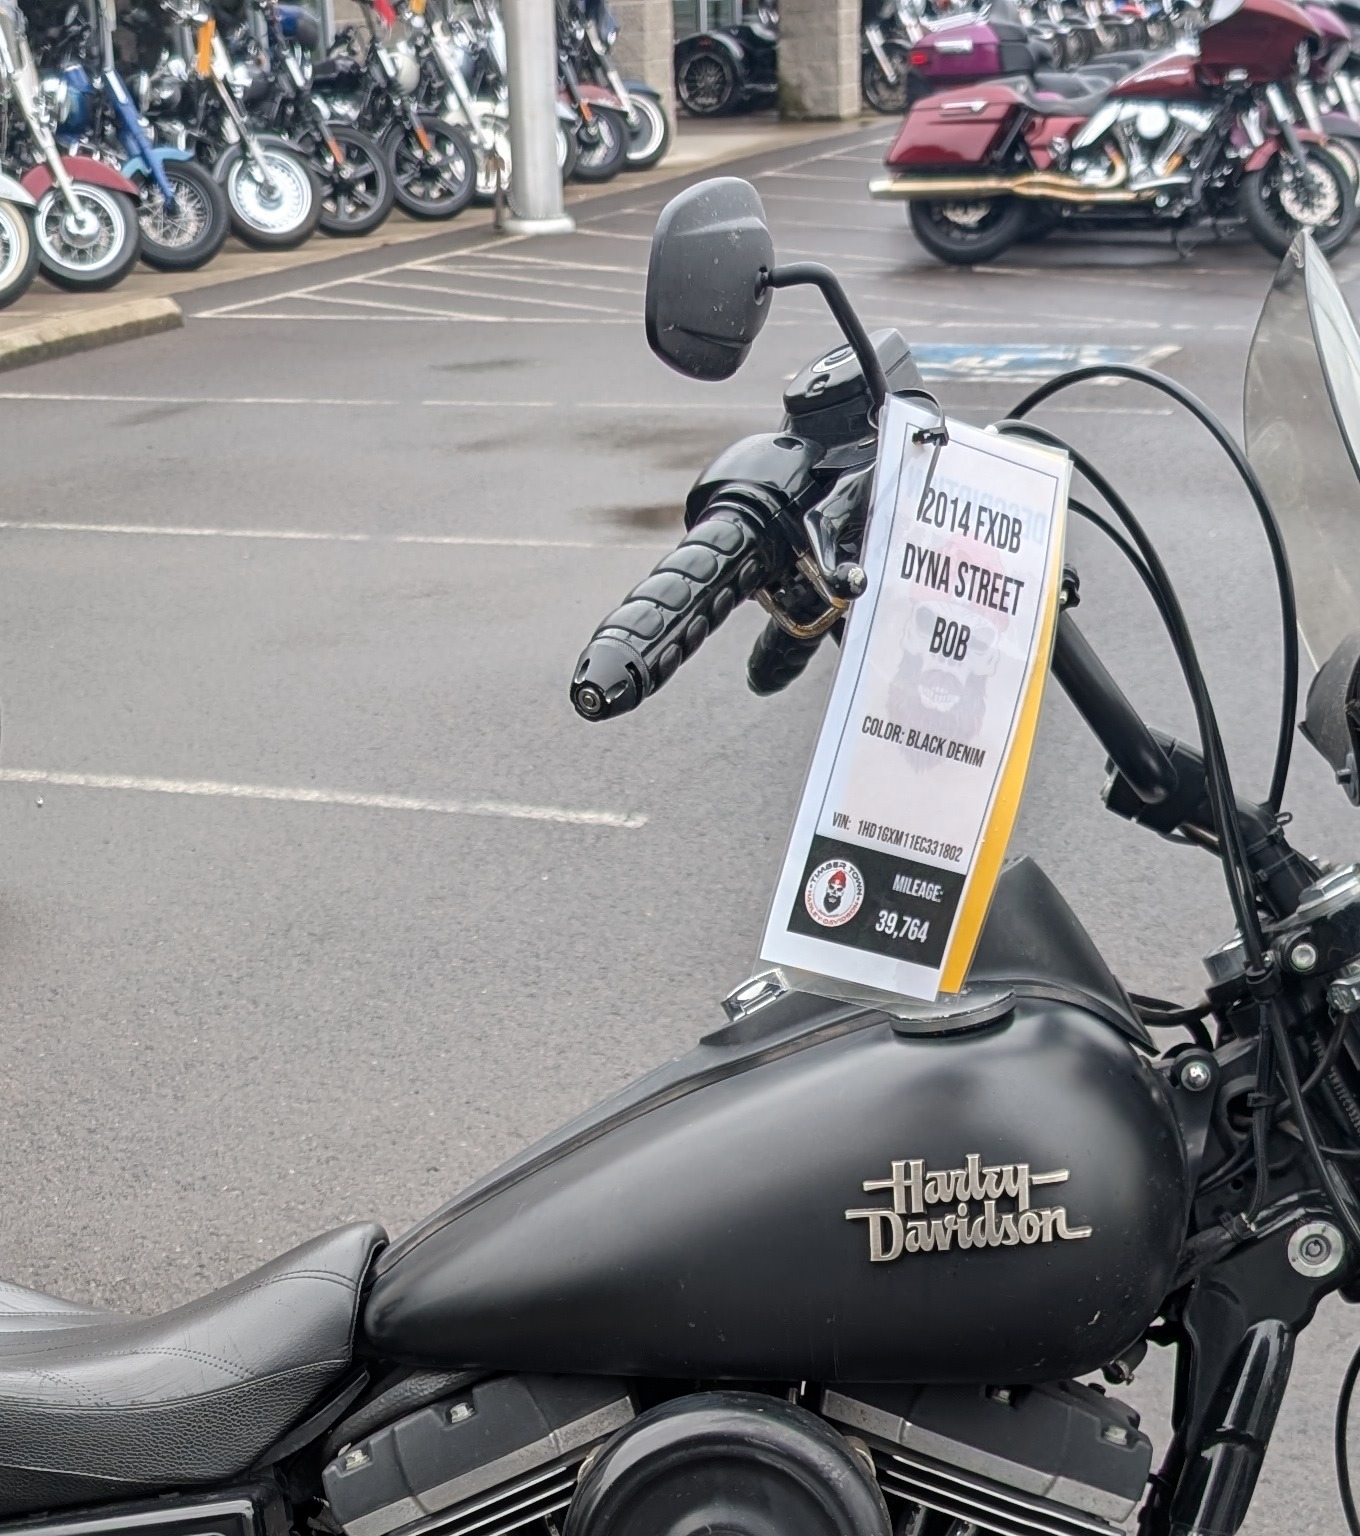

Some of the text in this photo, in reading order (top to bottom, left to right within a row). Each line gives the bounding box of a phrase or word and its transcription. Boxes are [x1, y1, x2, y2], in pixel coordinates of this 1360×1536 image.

[921, 487, 1023, 554] 2014 FXDB
[900, 542, 1025, 616] DYNA STREET
[929, 616, 971, 661] BOB
[861, 715, 986, 768] COLOR: BLACK DENIM
[832, 811, 852, 830] VIN:
[848, 866, 863, 896] TOWN
[892, 873, 944, 903] MILEAGE:
[875, 910, 930, 943] 39,764
[863, 1153, 1070, 1214] Harley
[844, 1200, 1093, 1262] Davidson
